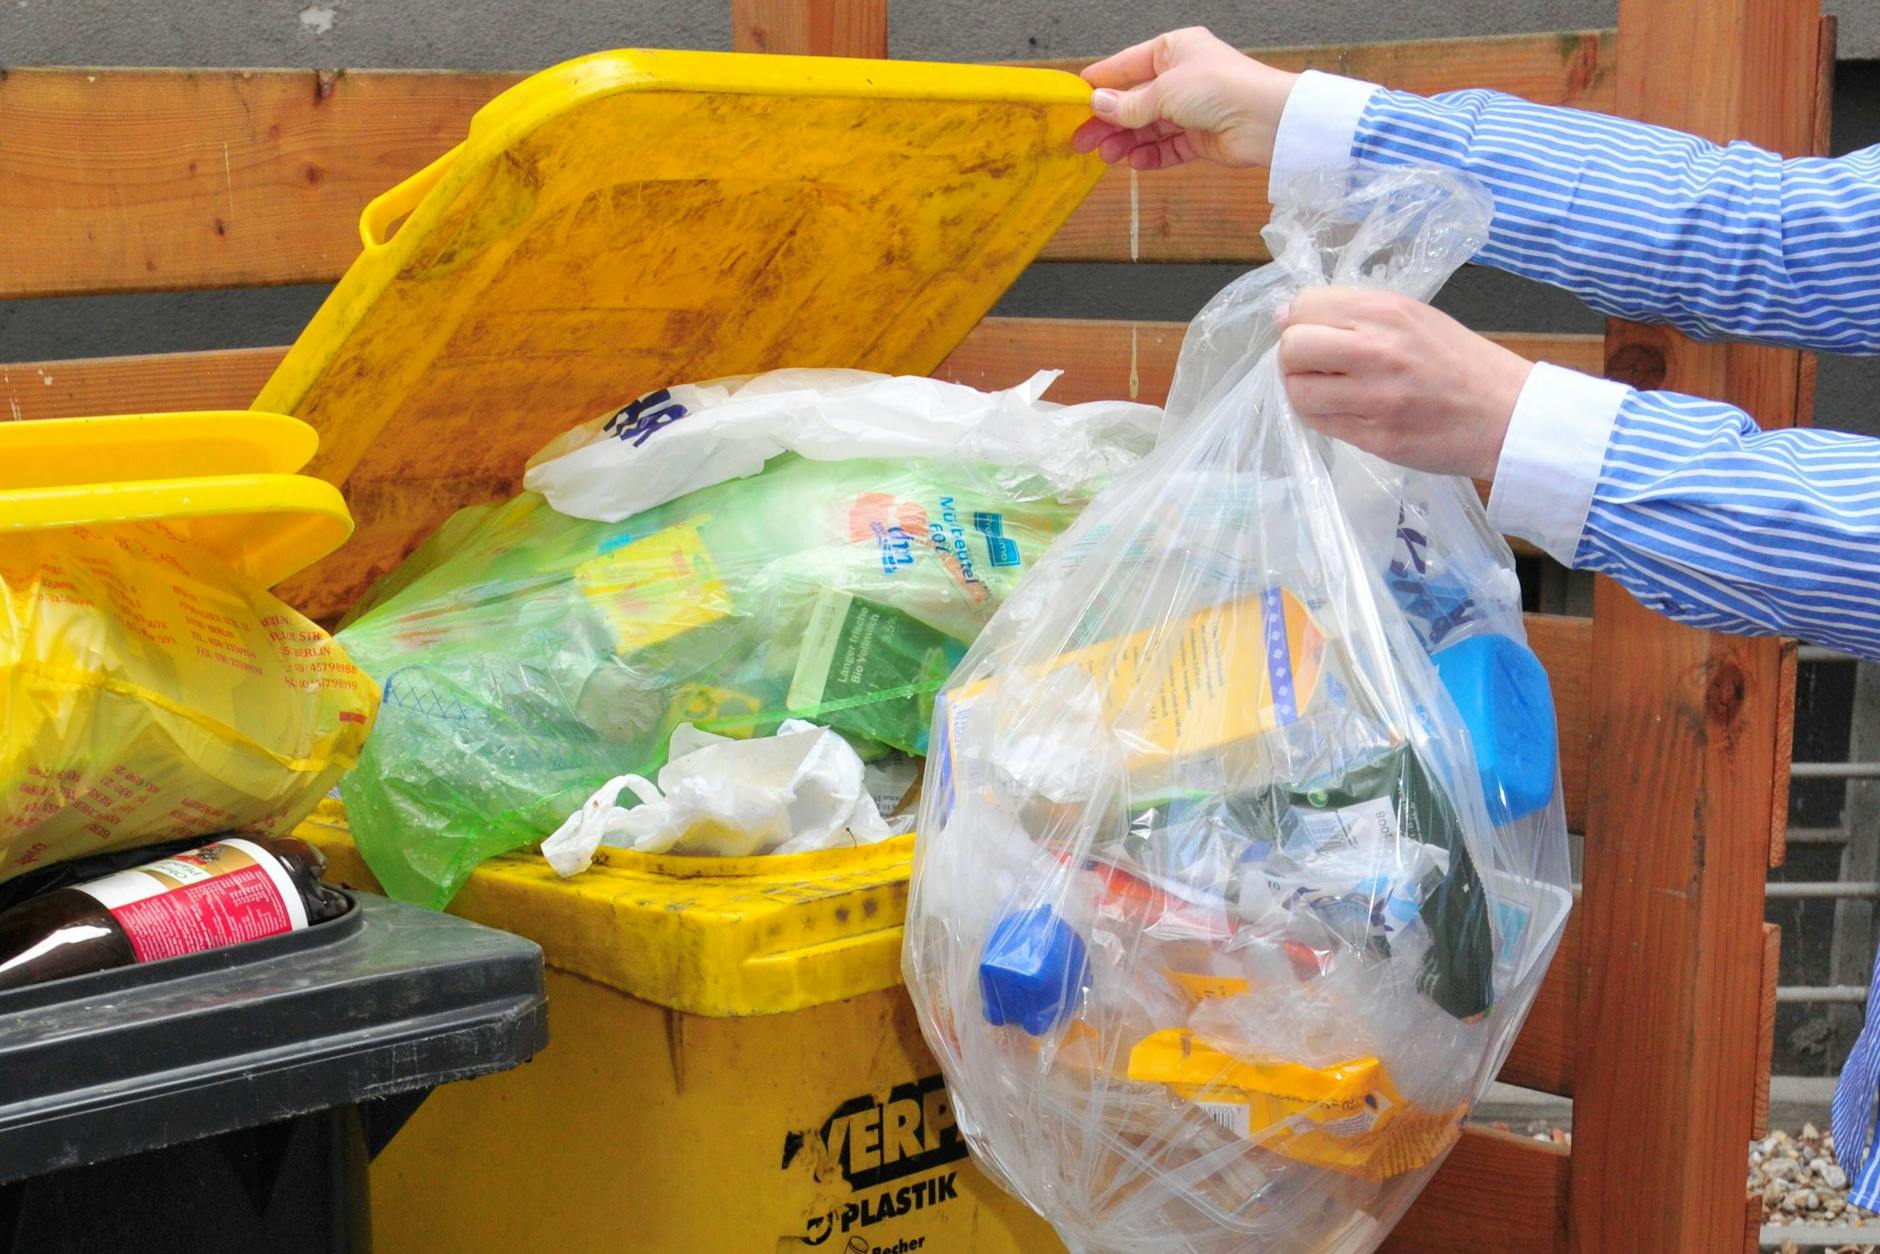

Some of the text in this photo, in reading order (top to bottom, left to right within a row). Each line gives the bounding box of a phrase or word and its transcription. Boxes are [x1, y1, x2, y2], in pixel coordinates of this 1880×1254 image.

[851, 664, 864, 684] Bio
[799, 1086, 967, 1182] VERP
[841, 1171, 959, 1233] PLASTIK
